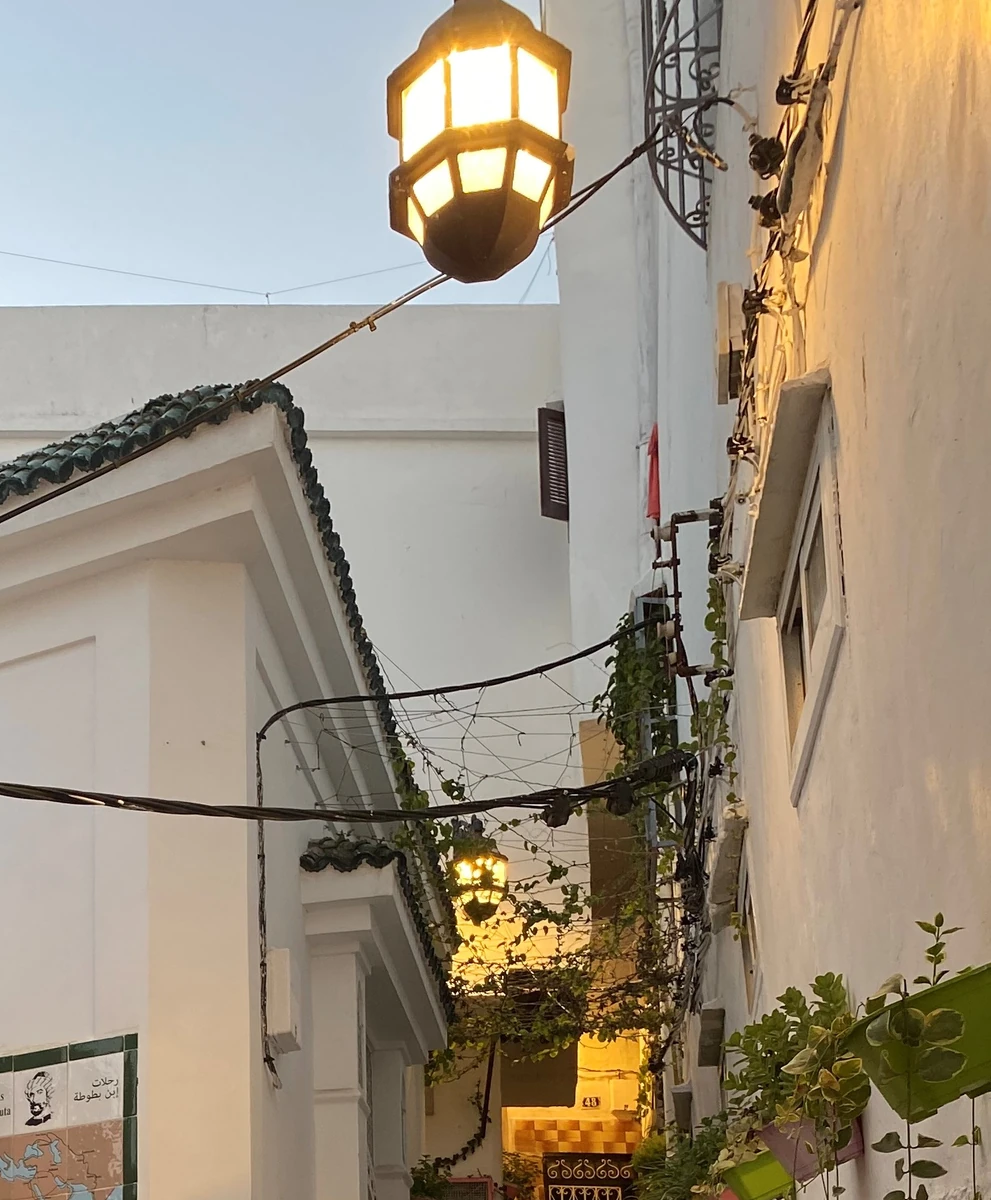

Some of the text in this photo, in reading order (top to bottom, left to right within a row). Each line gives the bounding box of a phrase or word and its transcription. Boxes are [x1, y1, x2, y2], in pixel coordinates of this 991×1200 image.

[91, 1076, 119, 1088] رحلات
[73, 1089, 102, 1103] بطوطة
[584, 1097, 597, 1107] 48
